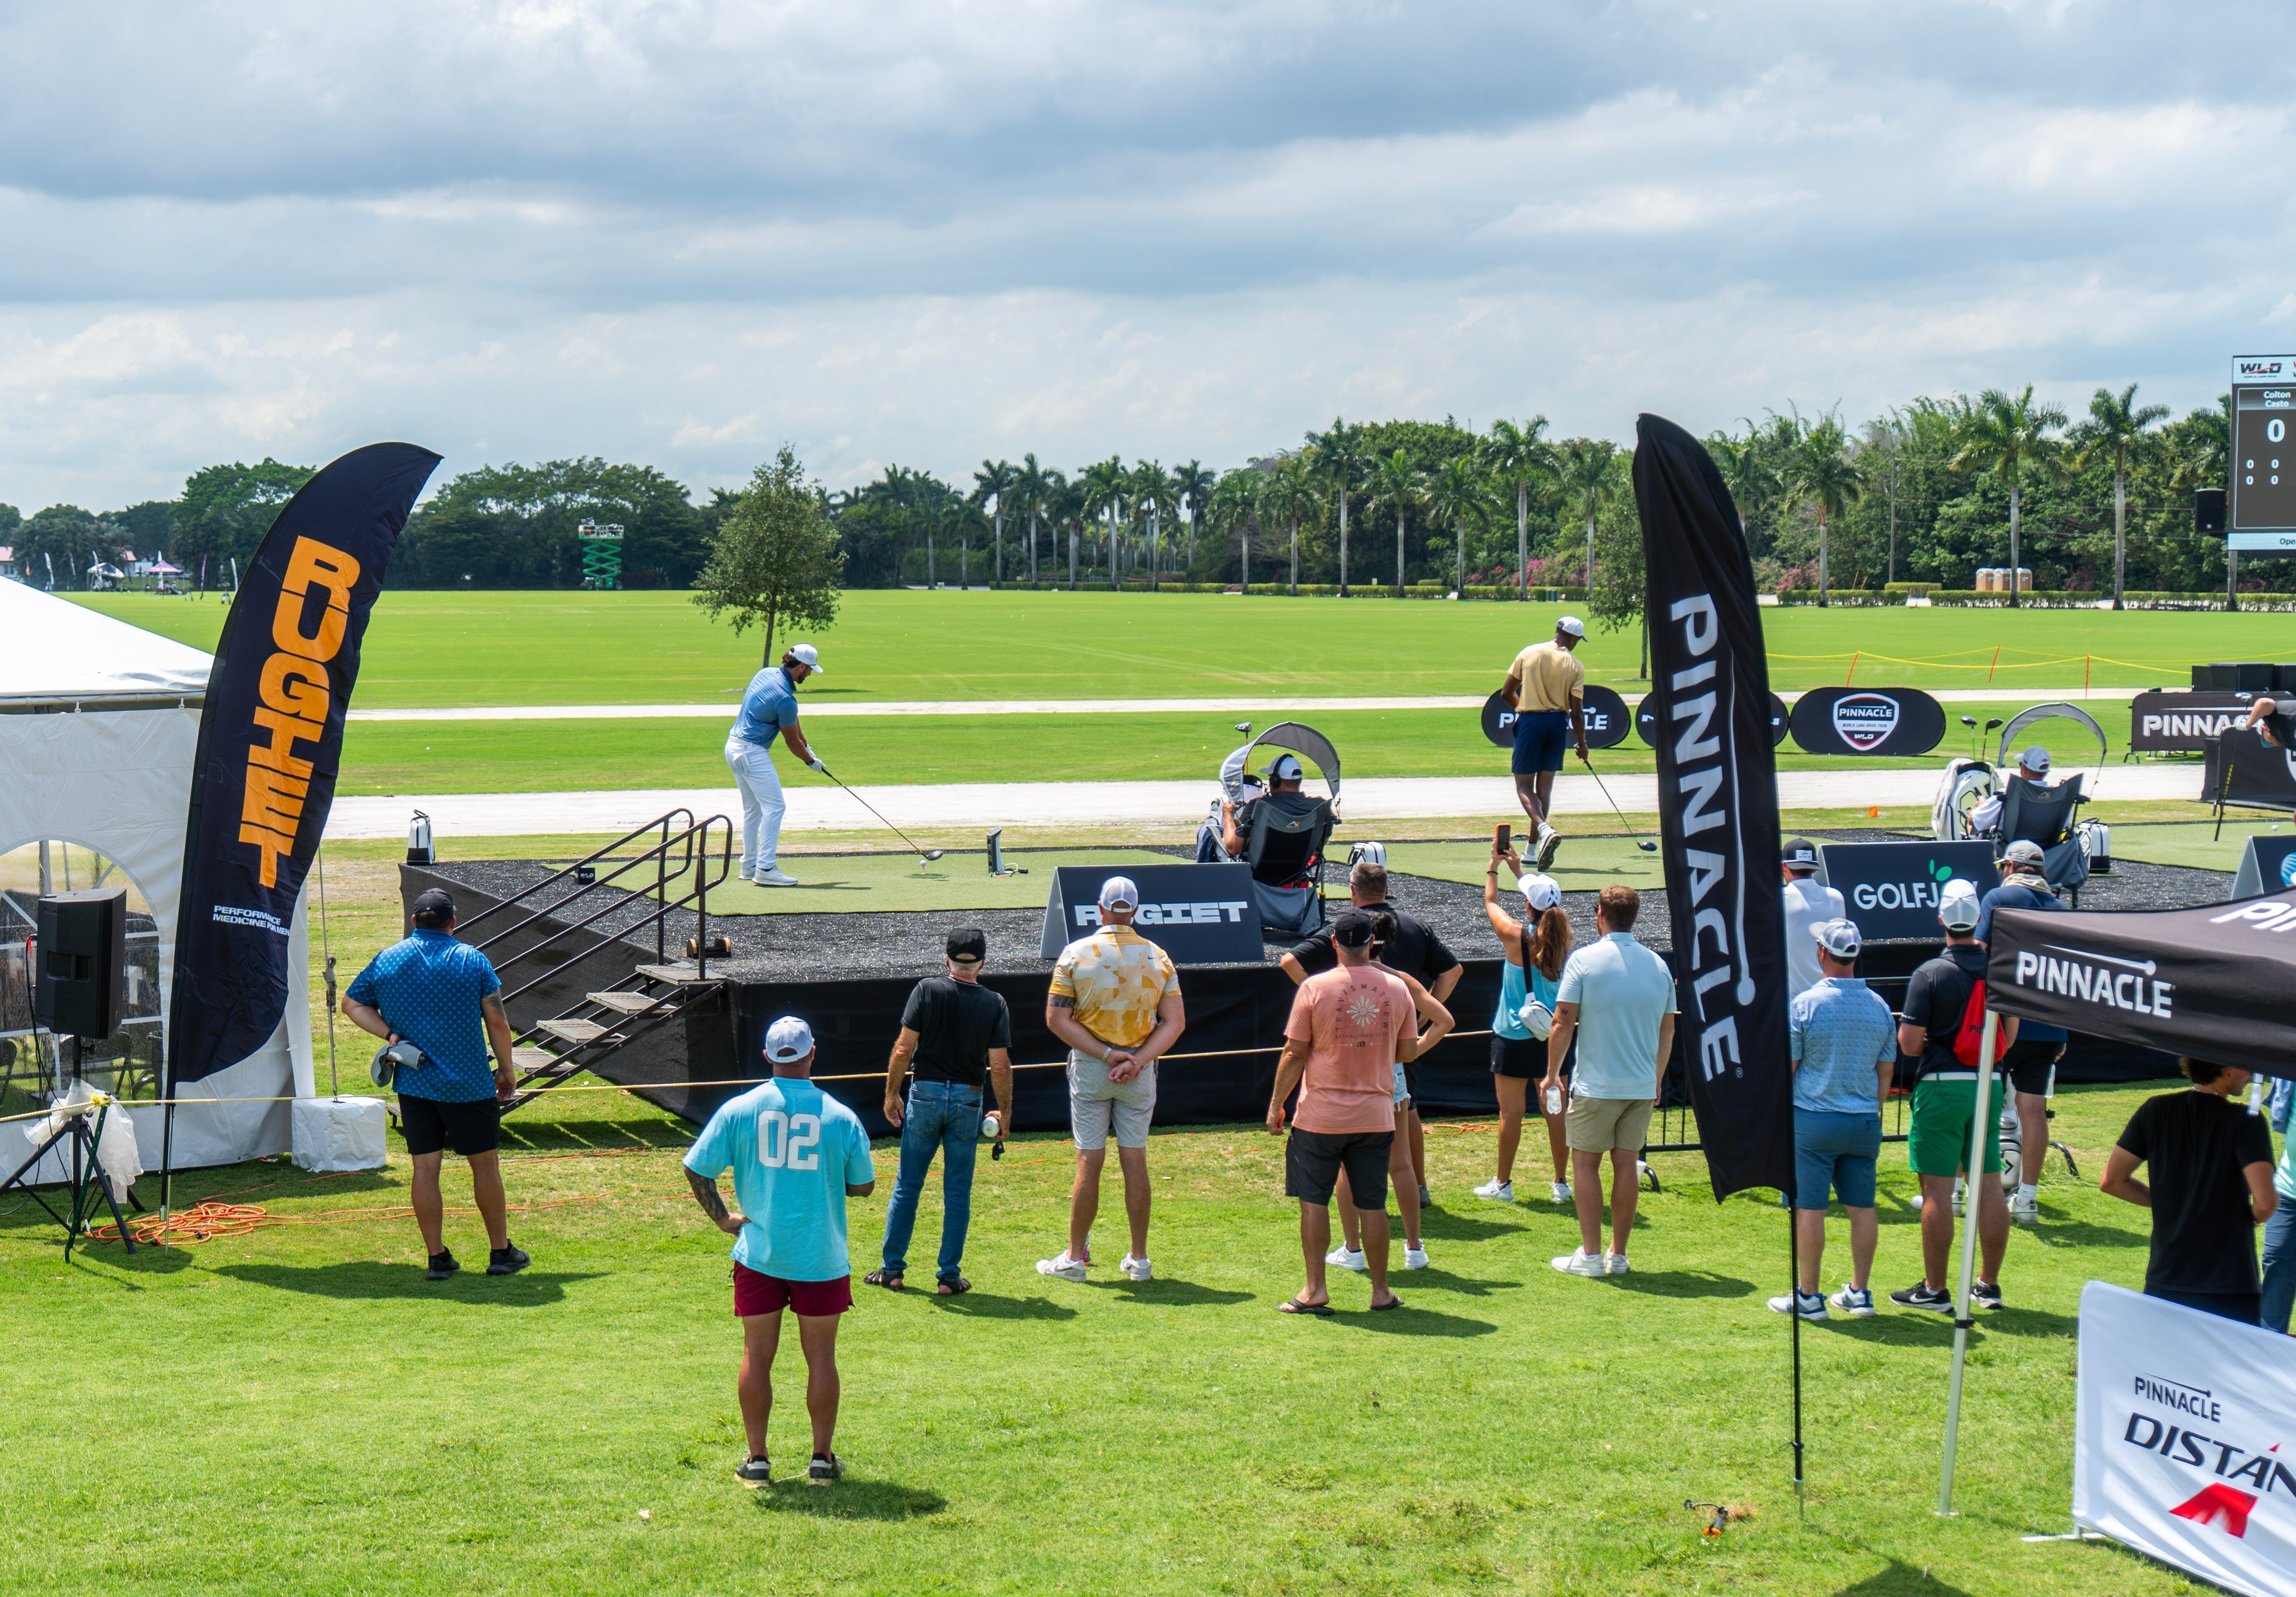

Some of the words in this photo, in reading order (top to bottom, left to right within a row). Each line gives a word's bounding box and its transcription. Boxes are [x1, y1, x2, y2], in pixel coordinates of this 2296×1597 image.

[2241, 363, 2282, 374] WLD
[2263, 390, 2291, 399] Colton
[2265, 399, 2289, 408] Casto
[2267, 419, 2285, 443] 0
[2246, 459, 2254, 469] 0
[2271, 459, 2279, 469] 0
[2245, 475, 2254, 485] 0
[2270, 475, 2278, 485] 0
[1839, 708, 1893, 717] PINNACLE
[1671, 594, 1741, 1081] PINNACLE
[214, 905, 281, 925] PERFORMANCE
[1074, 901, 1248, 926] RGIET
[212, 913, 267, 928] MEDICINE
[267, 922, 276, 932] FOR
[276, 926, 289, 936] MEN
[2016, 951, 2172, 1019] PINNACLE
[758, 1109, 822, 1171] 02
[2135, 1376, 2221, 1423] PINNACLE
